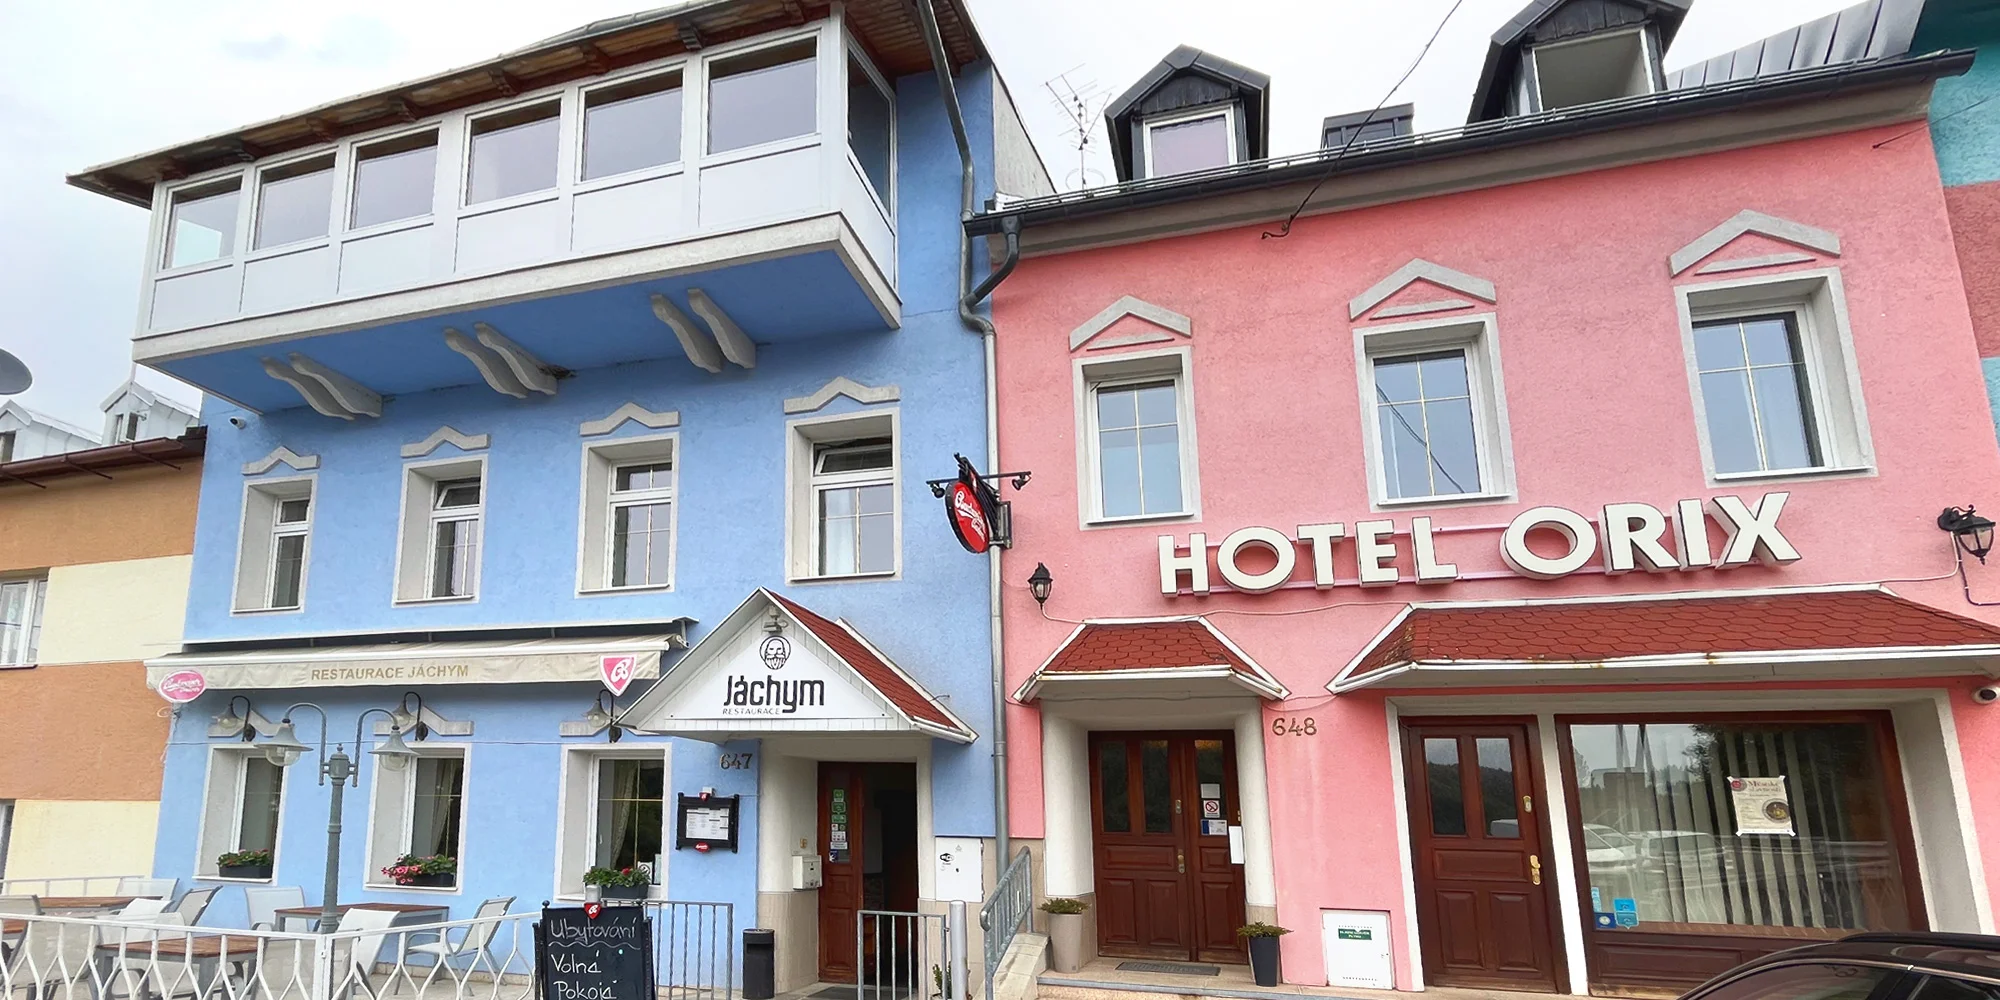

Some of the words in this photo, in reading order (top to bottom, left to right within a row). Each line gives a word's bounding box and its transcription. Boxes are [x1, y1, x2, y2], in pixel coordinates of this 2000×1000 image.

[1158, 516, 1458, 597] HOTEL
[1500, 491, 1802, 580] ORIX
[311, 667, 405, 681] RESTAURACE
[408, 664, 469, 679] JÁCHYM
[723, 674, 825, 714] Jáchym
[722, 707, 780, 715] RESTAURACE
[1272, 717, 1317, 737] 648
[720, 752, 753, 770] 647
[550, 916, 637, 945] Ubytování
[551, 949, 602, 974] Volná
